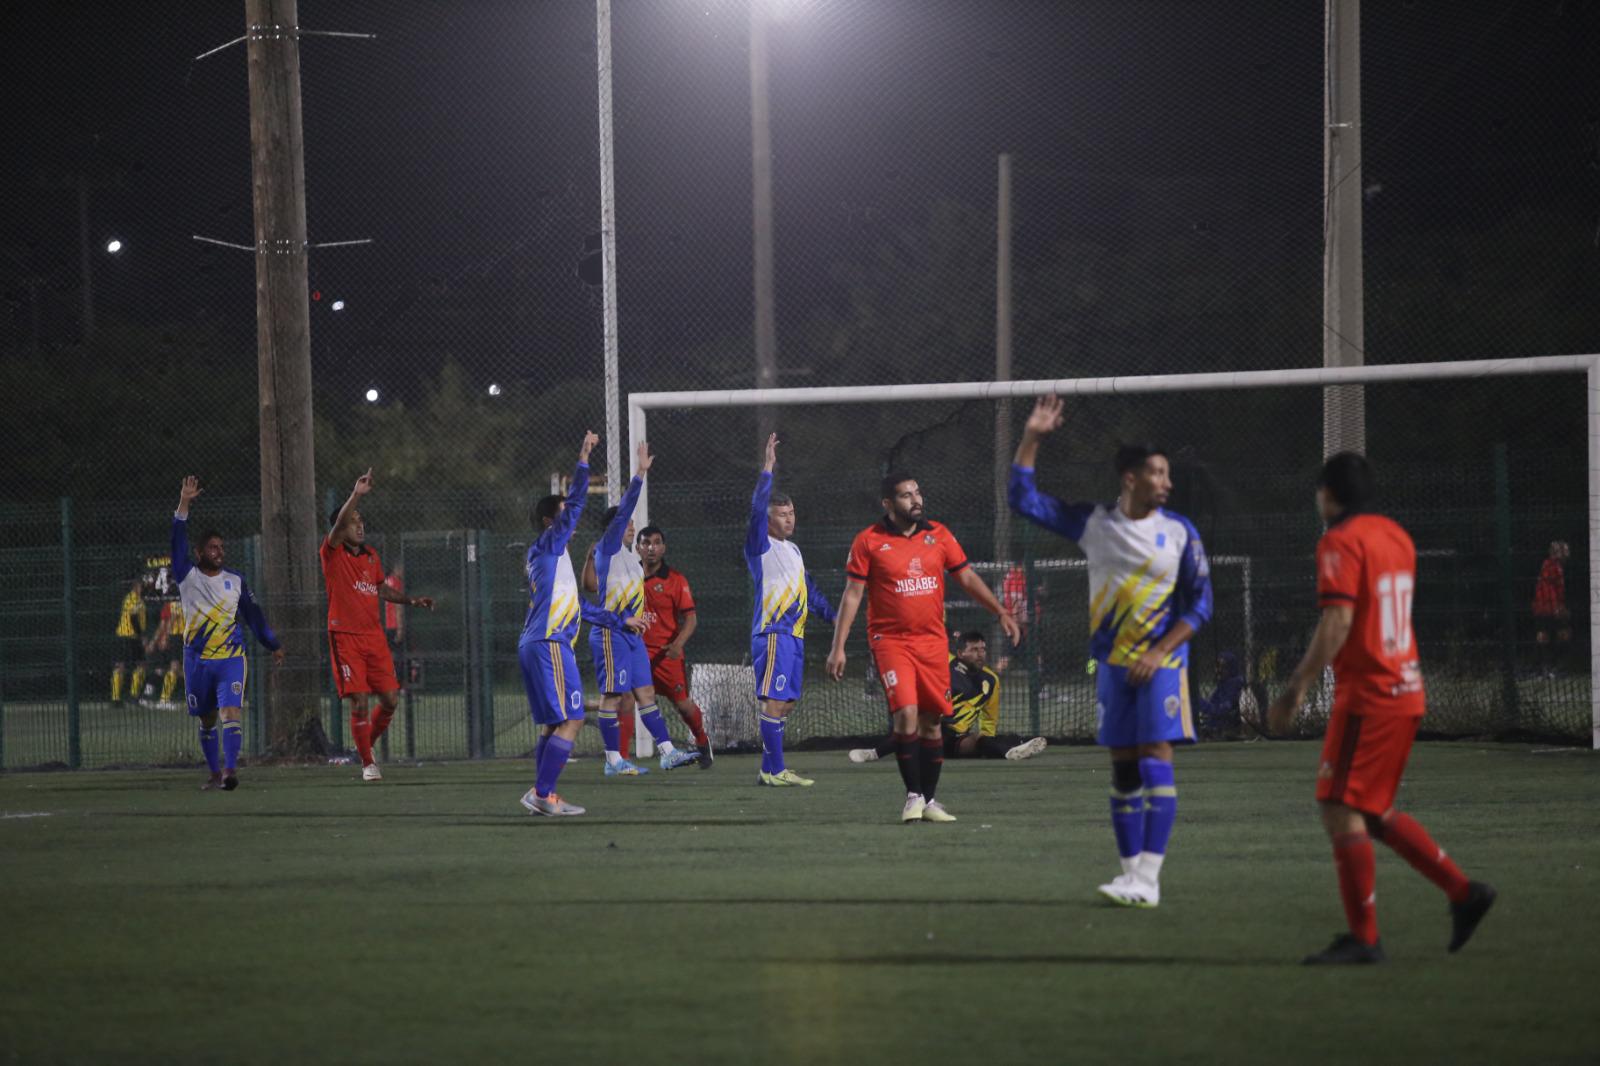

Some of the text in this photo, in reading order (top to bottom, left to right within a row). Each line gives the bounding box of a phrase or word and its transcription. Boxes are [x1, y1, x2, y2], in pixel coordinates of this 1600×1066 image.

[895, 576, 938, 593] JUSABEC
[1376, 571, 1413, 656] 10
[882, 670, 898, 688] 18
